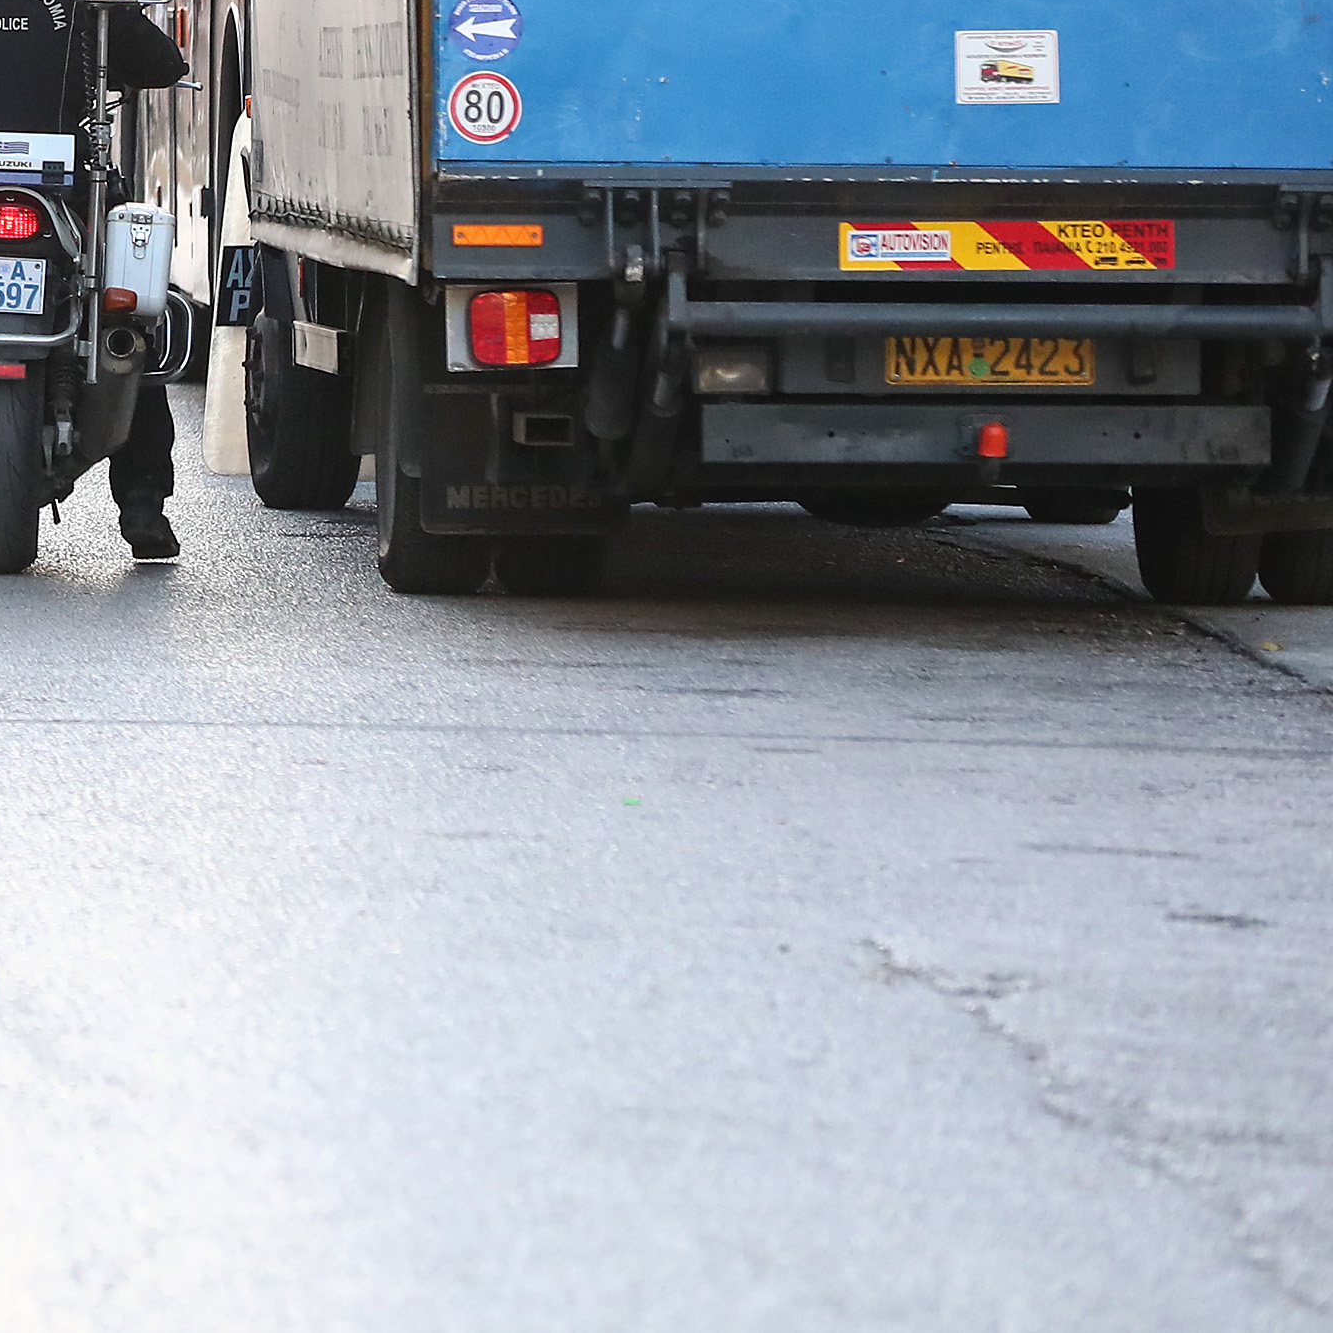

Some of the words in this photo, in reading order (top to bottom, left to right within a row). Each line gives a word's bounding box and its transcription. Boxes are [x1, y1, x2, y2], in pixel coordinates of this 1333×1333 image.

[464, 89, 504, 124] 80
[881, 233, 949, 251] AUTOVISION
[894, 337, 965, 376] NXA
[990, 337, 1084, 376] 2423
